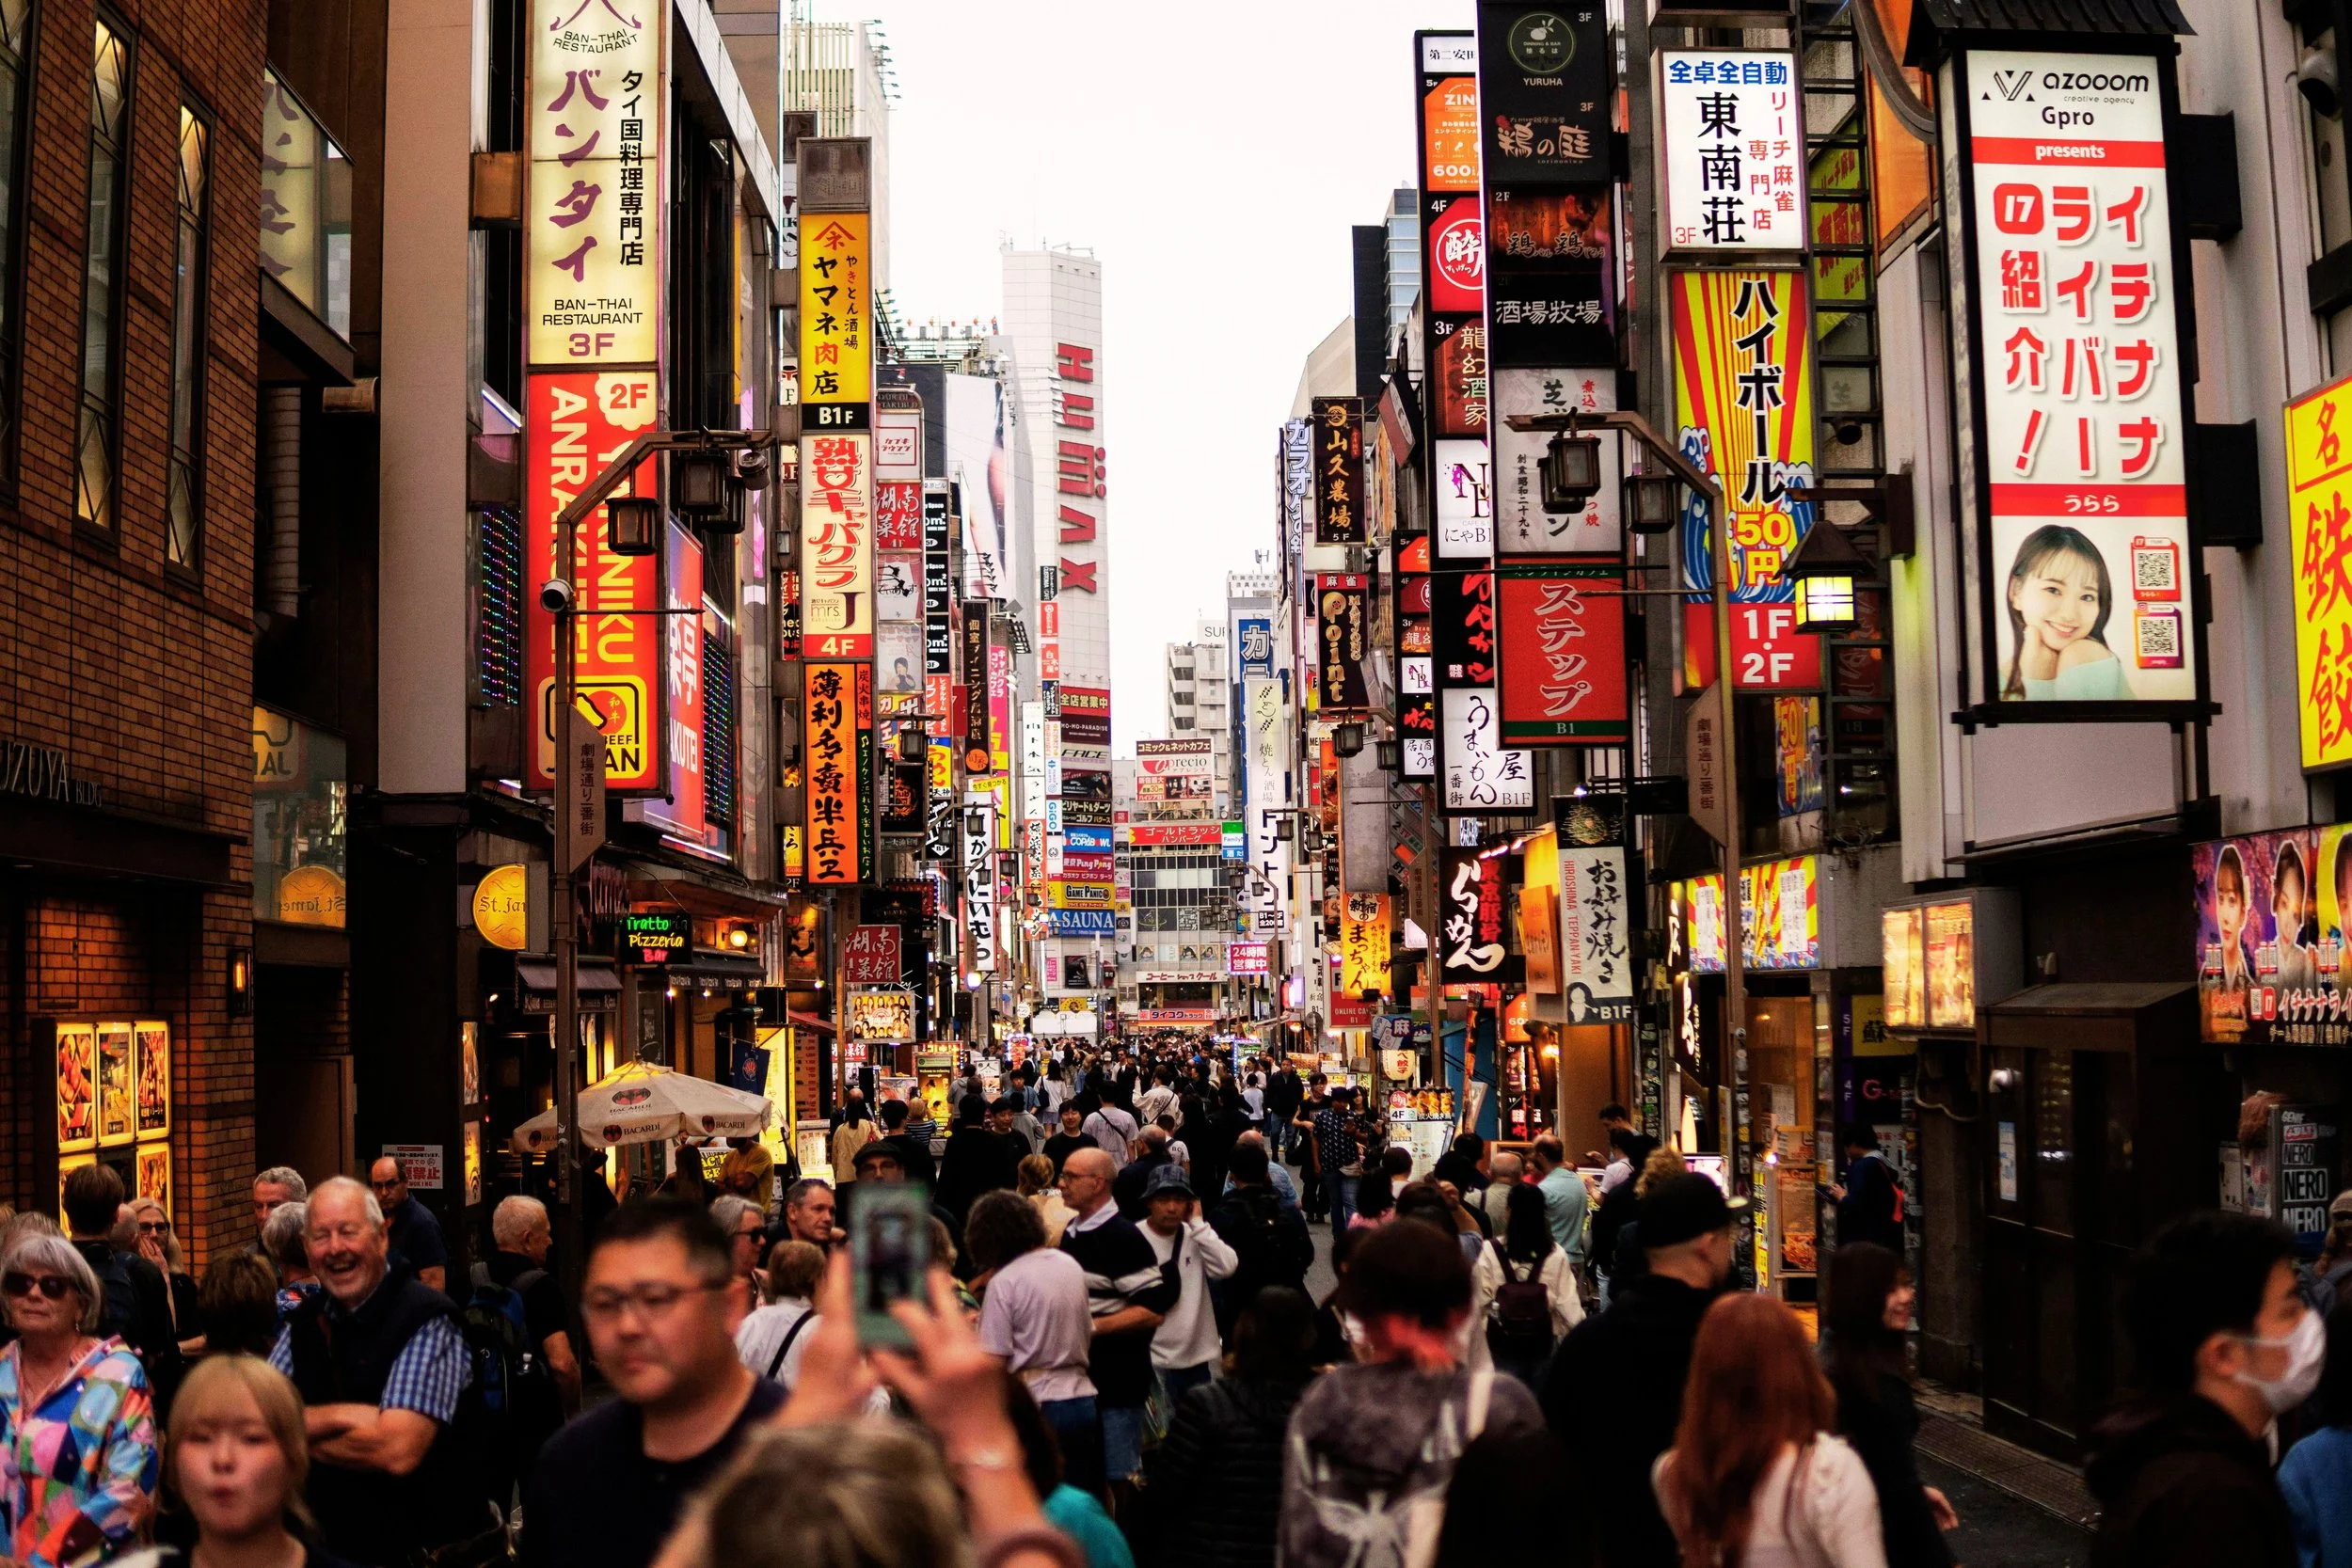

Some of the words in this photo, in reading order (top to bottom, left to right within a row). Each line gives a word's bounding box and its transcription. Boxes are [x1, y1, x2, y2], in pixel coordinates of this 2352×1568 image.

[1579, 12, 1592, 23] 3F
[552, 34, 638, 54] RESTAURANT
[564, 28, 628, 42] BAN-THAI
[1522, 77, 1564, 87] YURUHA
[1669, 59, 1788, 86] 全卓全自動
[2042, 71, 2150, 93] azooom
[1444, 93, 1476, 106] ZIN
[1580, 102, 1594, 112] 3F
[2063, 94, 2100, 103] creative
[2103, 95, 2136, 105] agency
[2042, 105, 2095, 130] Gpro
[1498, 122, 1595, 159] 鶏の庭
[1772, 91, 1795, 213] リーチ麻雀
[2034, 143, 2106, 160] presents
[547, 69, 611, 283] バンタイ
[618, 70, 644, 266] タイ国料理専門店
[1432, 165, 1471, 178] 600
[1695, 91, 1746, 245] 東南荘
[1748, 139, 1772, 230] 専門店
[1431, 200, 1447, 213] 4F
[1495, 191, 1511, 202] 2F
[1675, 227, 1697, 245] 3F
[553, 297, 633, 311] BAN-THAI
[843, 255, 860, 351] やきとん酒場
[1495, 299, 1604, 325] 酒場牧場
[541, 311, 644, 326] RESTAURANT
[810, 256, 840, 396] ヤマネ肉店
[1434, 320, 1454, 335] 3F
[567, 332, 616, 357] 3F
[609, 382, 649, 410] 2F
[1731, 278, 1787, 506] ハイボール
[818, 405, 854, 425] B1F
[1327, 430, 1351, 530] 山久農場
[1516, 452, 1531, 540] 創業昭和二十九年
[2063, 494, 2122, 514] うらら
[1332, 532, 1350, 542] 5F
[1737, 512, 1790, 546] 50
[1326, 575, 1358, 588] 麻雀
[1742, 609, 1793, 640] 1F
[820, 637, 856, 656] 4F
[1533, 582, 1593, 717] ステップ
[1741, 652, 1795, 684] 2F
[1060, 693, 1109, 709] 全店営業中
[1555, 721, 1576, 735] B1
[669, 717, 699, 775] AKUTEI
[1137, 741, 1211, 752] コミック&ネットカフェ
[1696, 717, 1715, 810] 劇場通り一番街
[580, 742, 596, 837] 劇場通り一番街
[1448, 764, 1465, 807] 一番街
[1502, 793, 1532, 806] B1F
[1048, 801, 1057, 832] GiGO
[1161, 834, 1201, 844] ハンバーグ
[1564, 859, 1576, 911] HIROSHIMA
[1061, 911, 1115, 928] SAUNA
[1582, 858, 1627, 984] お好み焼き
[628, 933, 685, 948] Pizzeria
[1566, 915, 1582, 975] TEPPANYAKI
[643, 947, 669, 963] Bar
[1232, 946, 1268, 958] 24時間
[1232, 958, 1268, 970] 営業中
[1334, 1006, 1357, 1015] ONLINE
[1599, 1006, 1632, 1020] B1F
[624, 1124, 660, 1136] BACARDI
[716, 1120, 746, 1132] BACARDI
